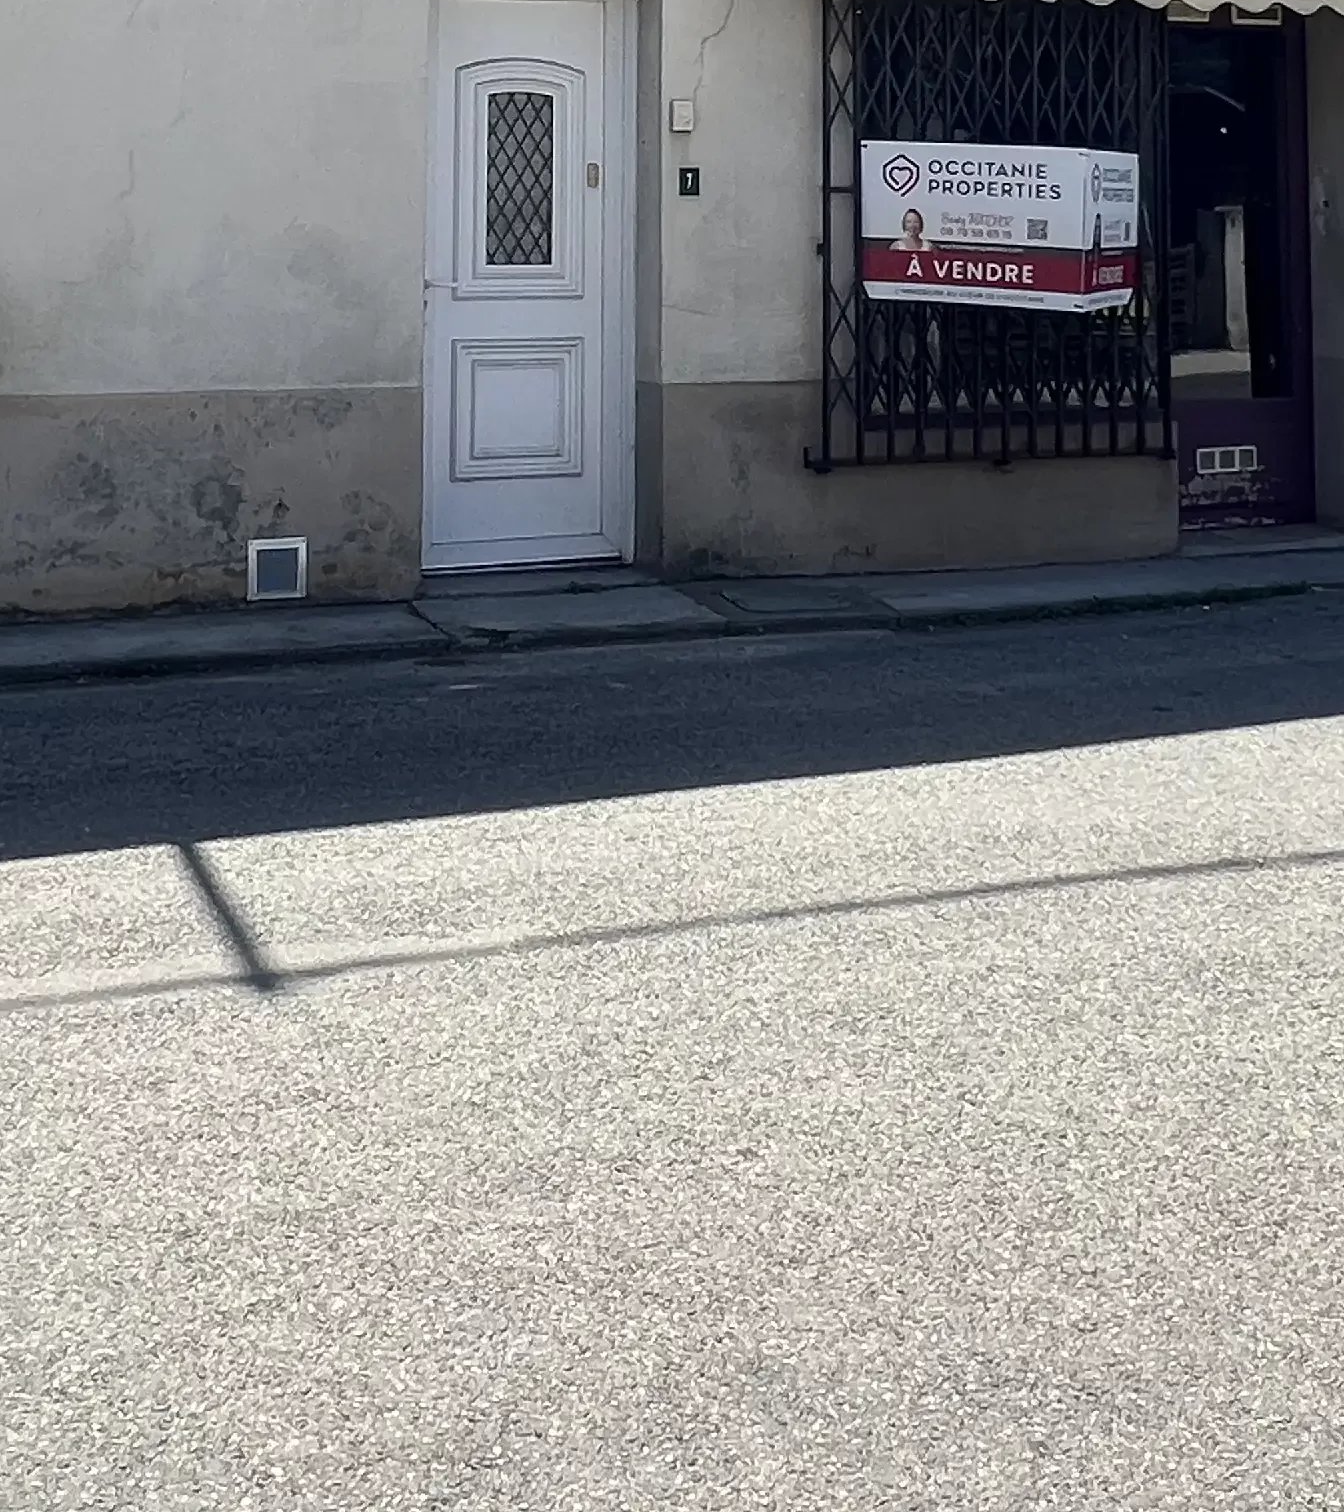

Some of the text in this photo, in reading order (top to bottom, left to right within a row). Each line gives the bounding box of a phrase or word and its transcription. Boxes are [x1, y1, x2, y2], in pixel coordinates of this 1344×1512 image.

[928, 159, 1048, 180] OCCITANIE
[928, 178, 1061, 200] PROPERTIES
[932, 259, 1034, 285] VENDRE
